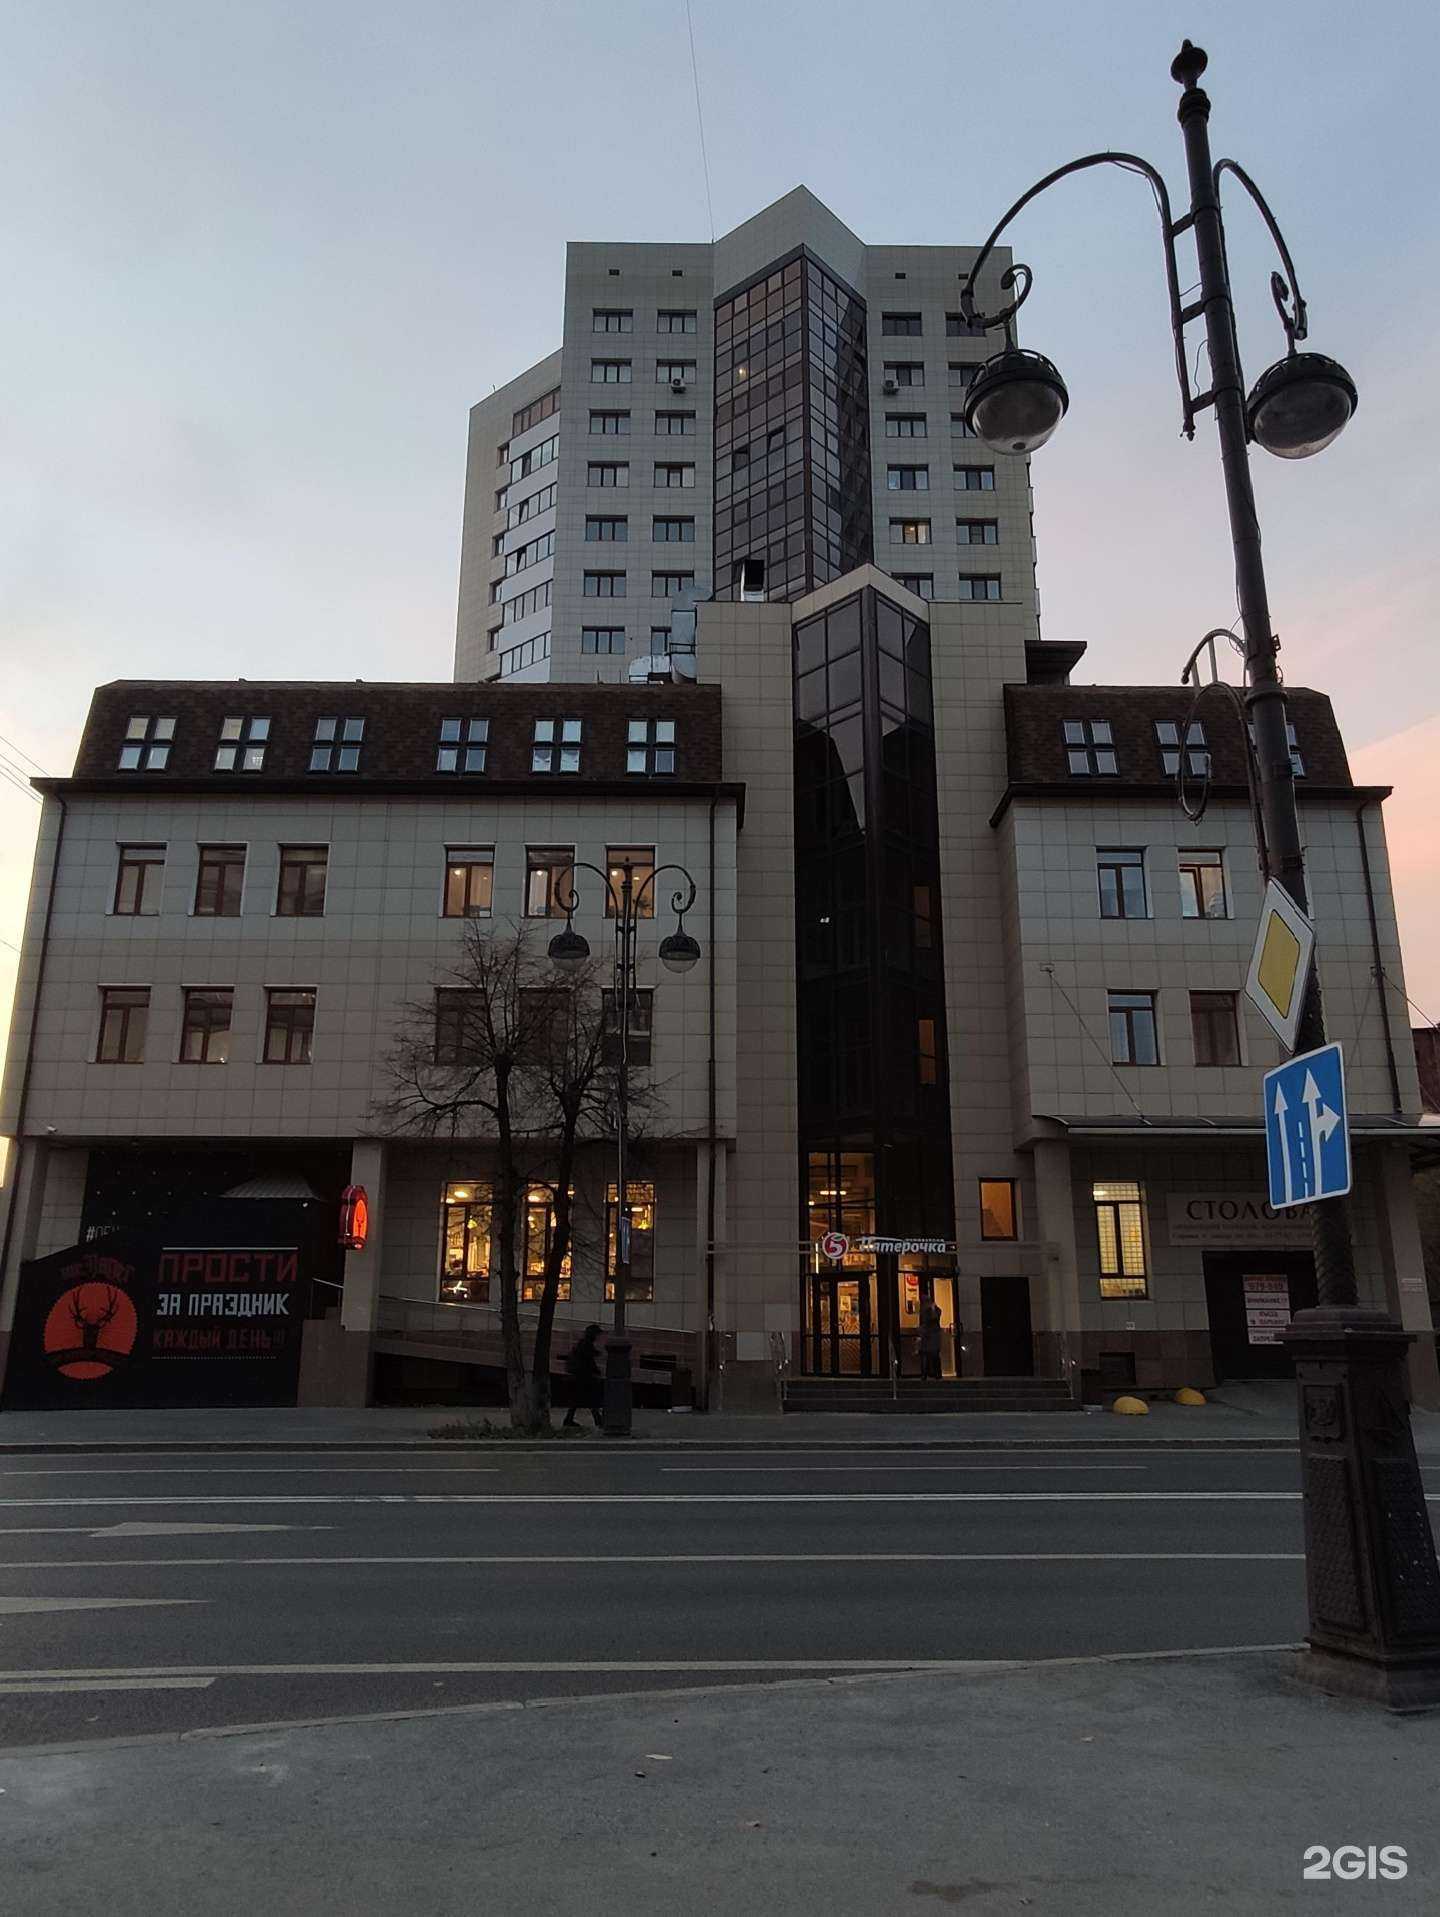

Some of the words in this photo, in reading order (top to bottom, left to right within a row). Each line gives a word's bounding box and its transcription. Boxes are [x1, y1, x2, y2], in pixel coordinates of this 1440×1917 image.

[1186, 1200, 1313, 1220] СТОЛОВА
[158, 1253, 298, 1282] ПРОСТИ
[156, 1293, 181, 1316] ЗА
[187, 1293, 290, 1318] ПРАЗДНИК
[152, 1325, 222, 1350] КАЖДЫЙ
